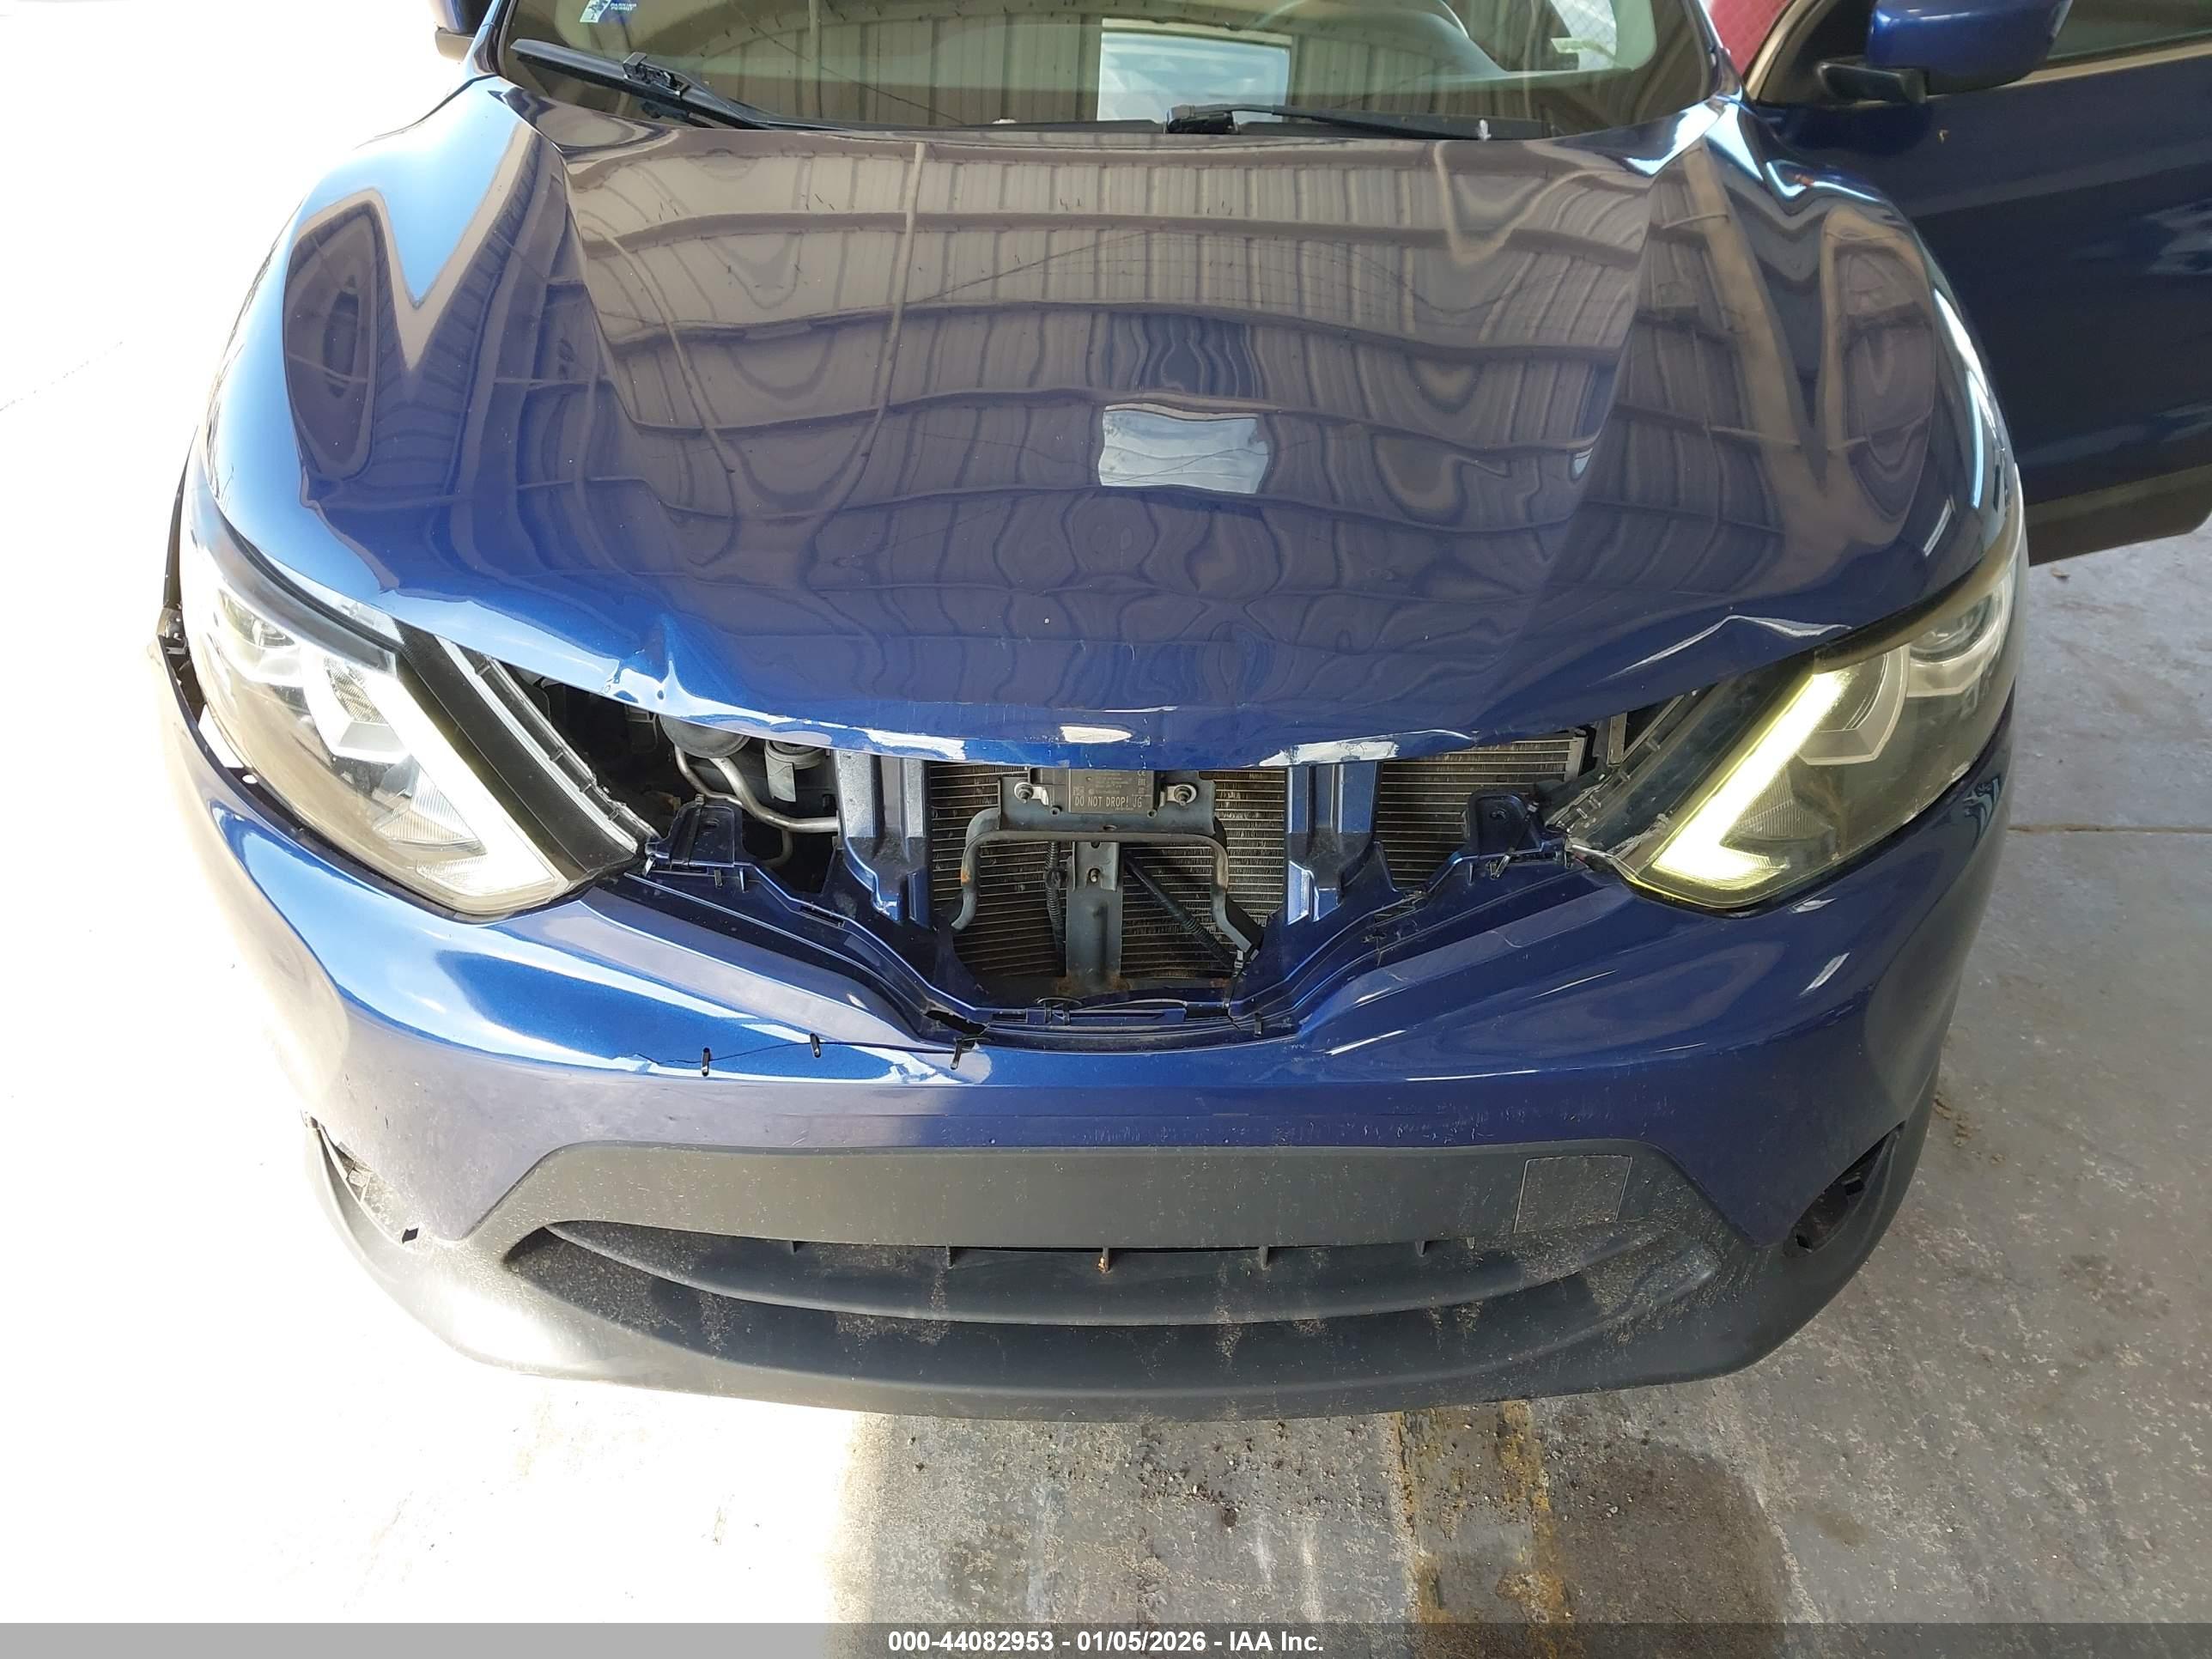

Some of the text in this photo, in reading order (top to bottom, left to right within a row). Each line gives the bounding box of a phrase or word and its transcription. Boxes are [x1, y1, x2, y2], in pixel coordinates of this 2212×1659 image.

[1074, 796, 1143, 808] DO NOT DROP! JG
